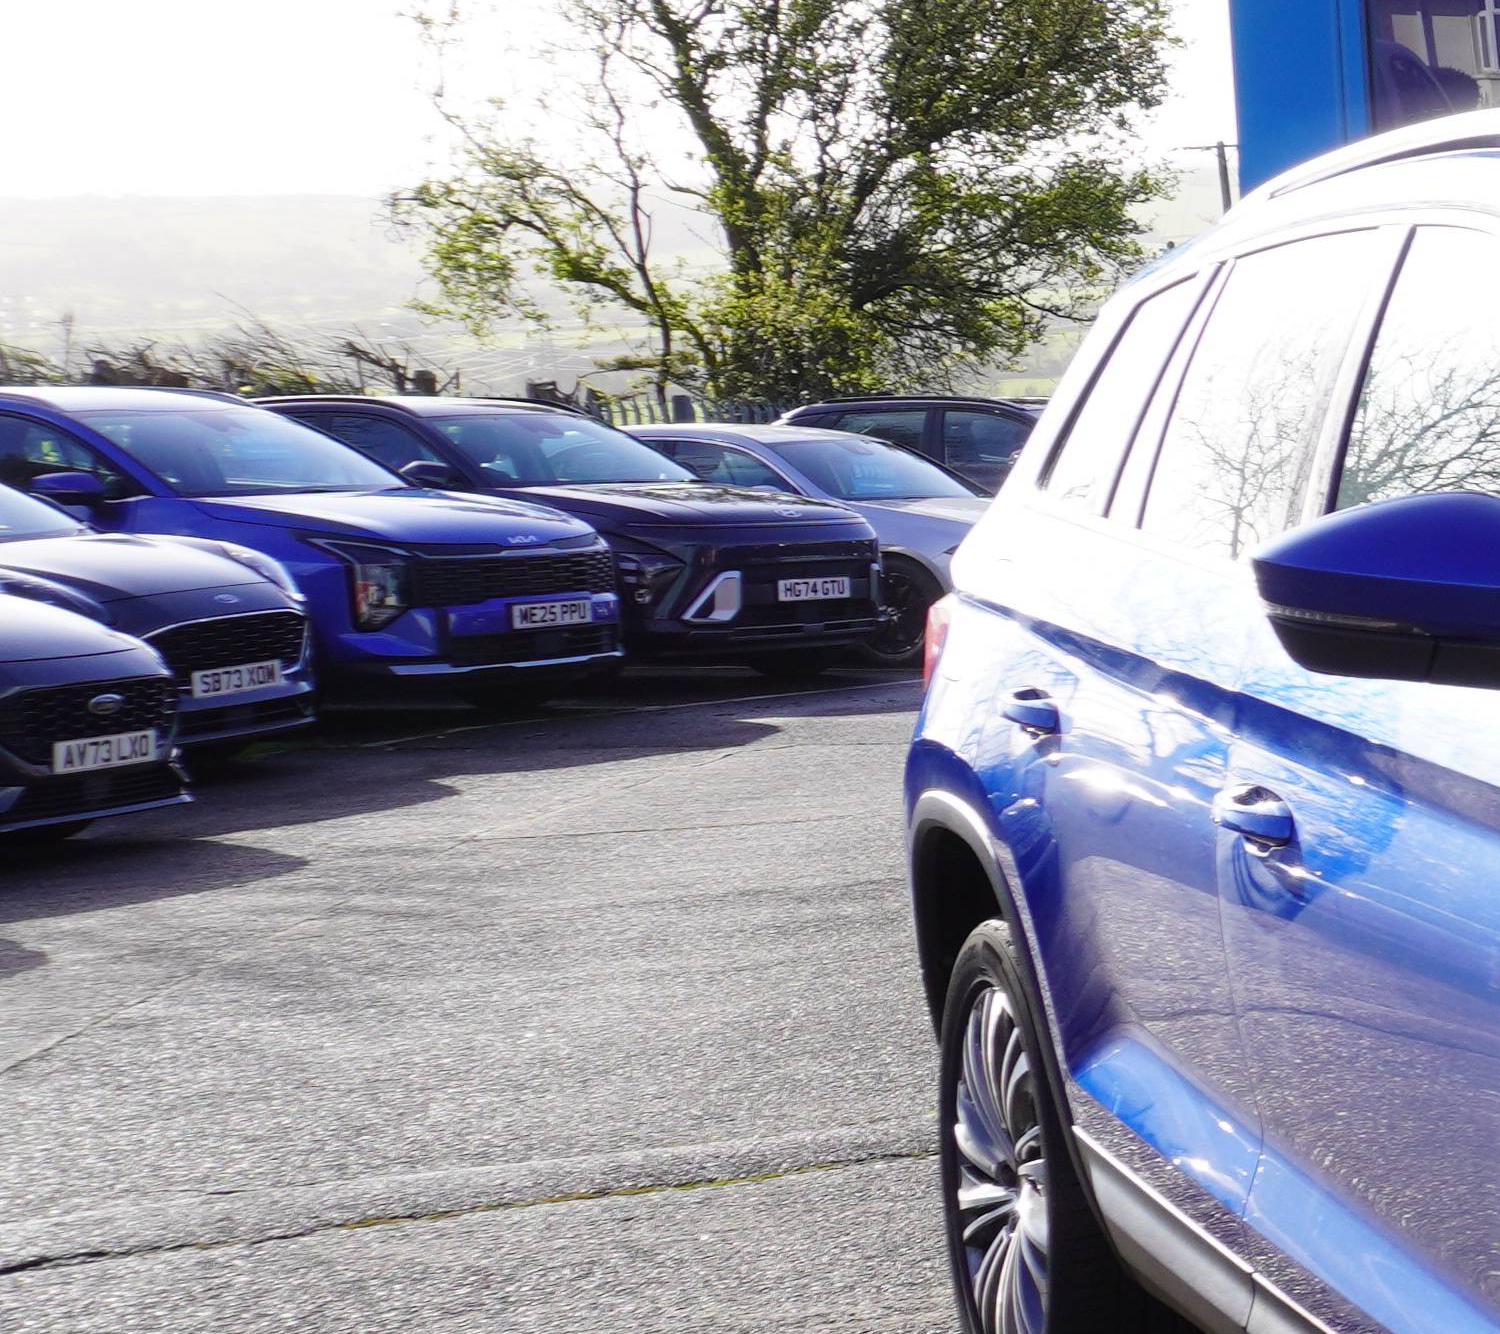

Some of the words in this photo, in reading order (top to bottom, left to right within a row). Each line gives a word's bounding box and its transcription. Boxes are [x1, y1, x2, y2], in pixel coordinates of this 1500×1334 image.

[784, 581, 818, 597] HG74
[822, 580, 845, 595] GTU
[519, 605, 557, 625] ME25
[561, 602, 587, 621] PPU
[201, 671, 243, 694] SB73
[64, 741, 112, 769] AV73
[118, 735, 149, 759] LXO
